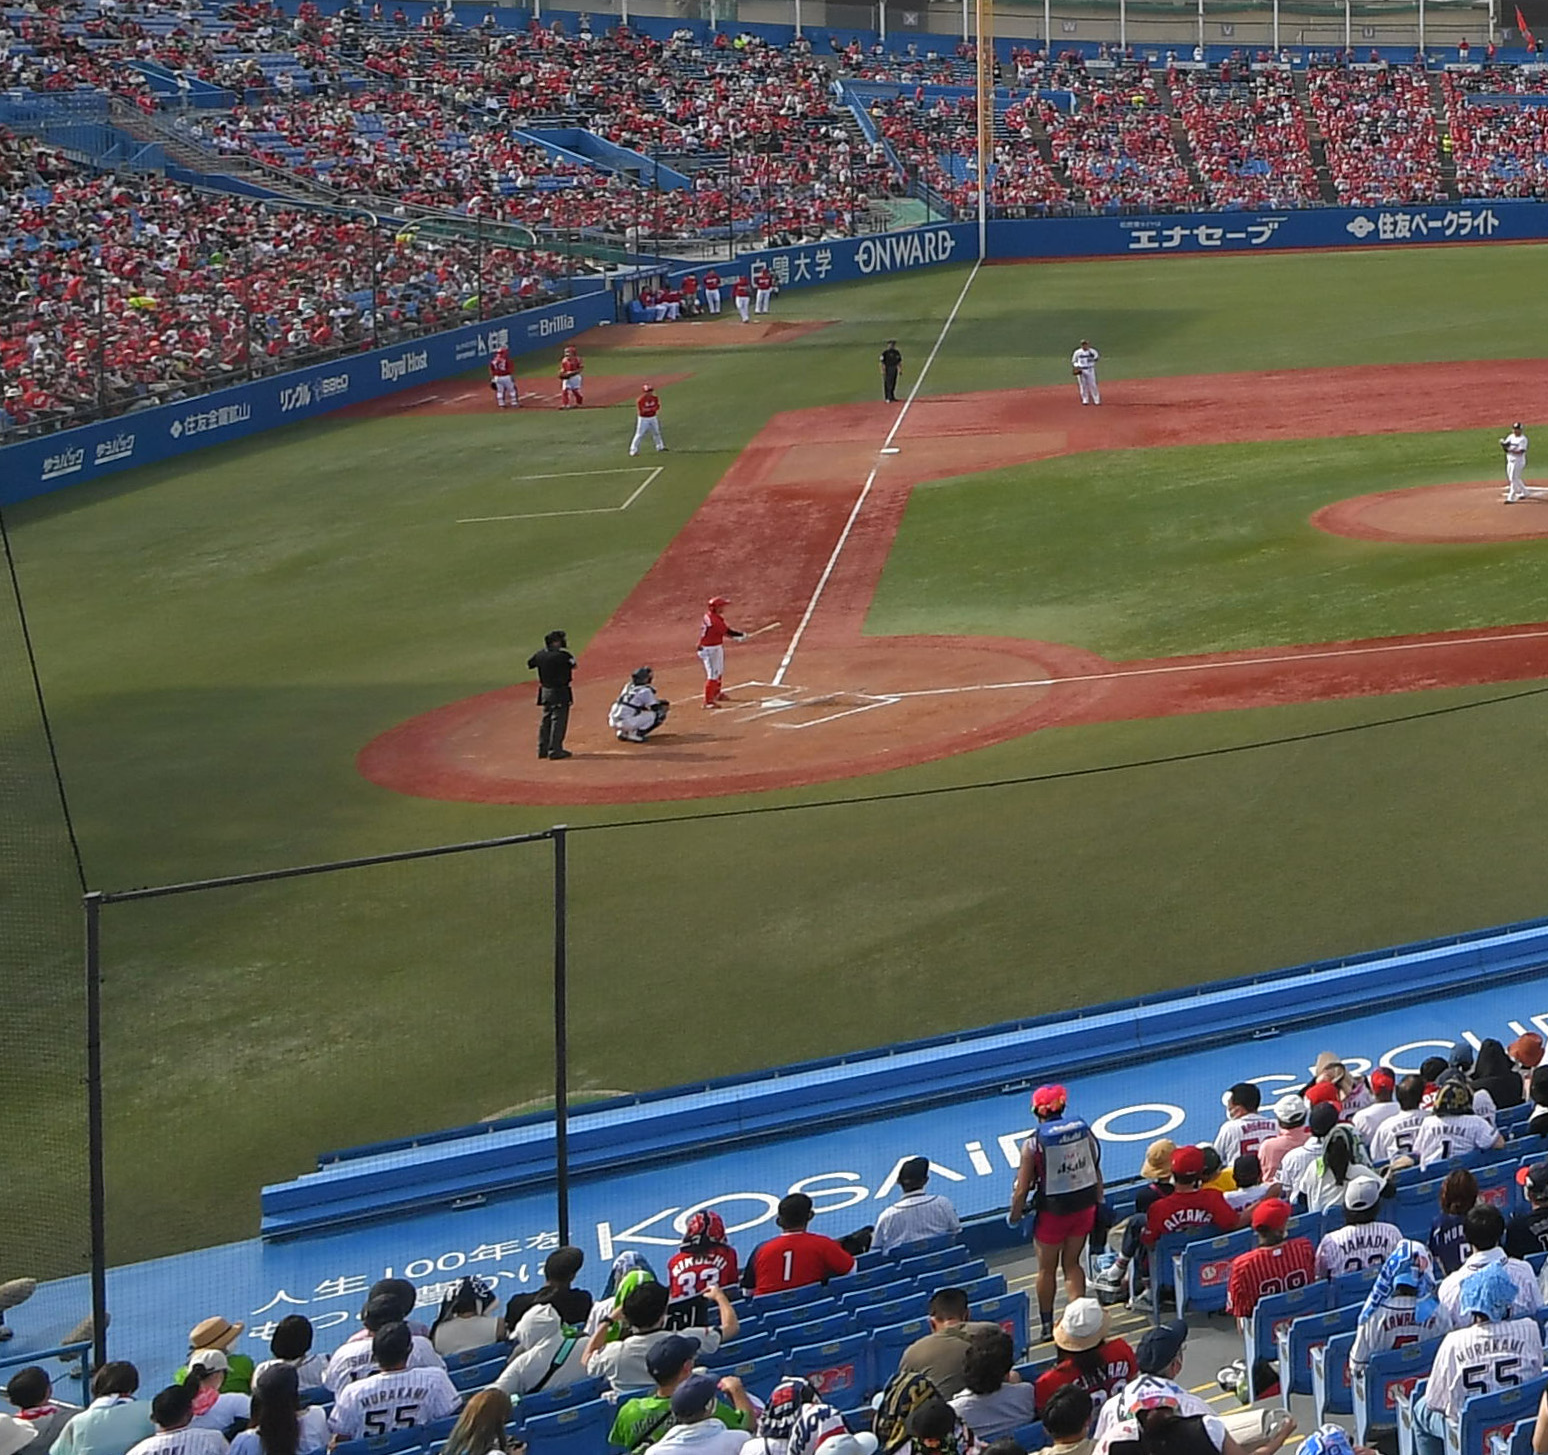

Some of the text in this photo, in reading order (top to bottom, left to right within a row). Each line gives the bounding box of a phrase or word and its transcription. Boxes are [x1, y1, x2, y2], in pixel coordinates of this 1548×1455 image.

[1129, 221, 1280, 250] エナセーブ
[1378, 209, 1500, 240] 住友ベークライト
[853, 229, 956, 274] ONWARD
[540, 314, 574, 337] Brillia
[596, 1102, 1187, 1261] KOSAIDO
[1163, 1207, 1213, 1232] AIZAWA
[1338, 1233, 1390, 1256] YAMADA
[671, 1250, 728, 1276] KIKUCHI
[781, 1250, 793, 1282] 1
[677, 1268, 721, 1299] 33
[1456, 1339, 1525, 1364] MURAKAMI
[1462, 1357, 1523, 1395] 55
[360, 1387, 429, 1410] MURAKAMI
[364, 1404, 420, 1439] 55
